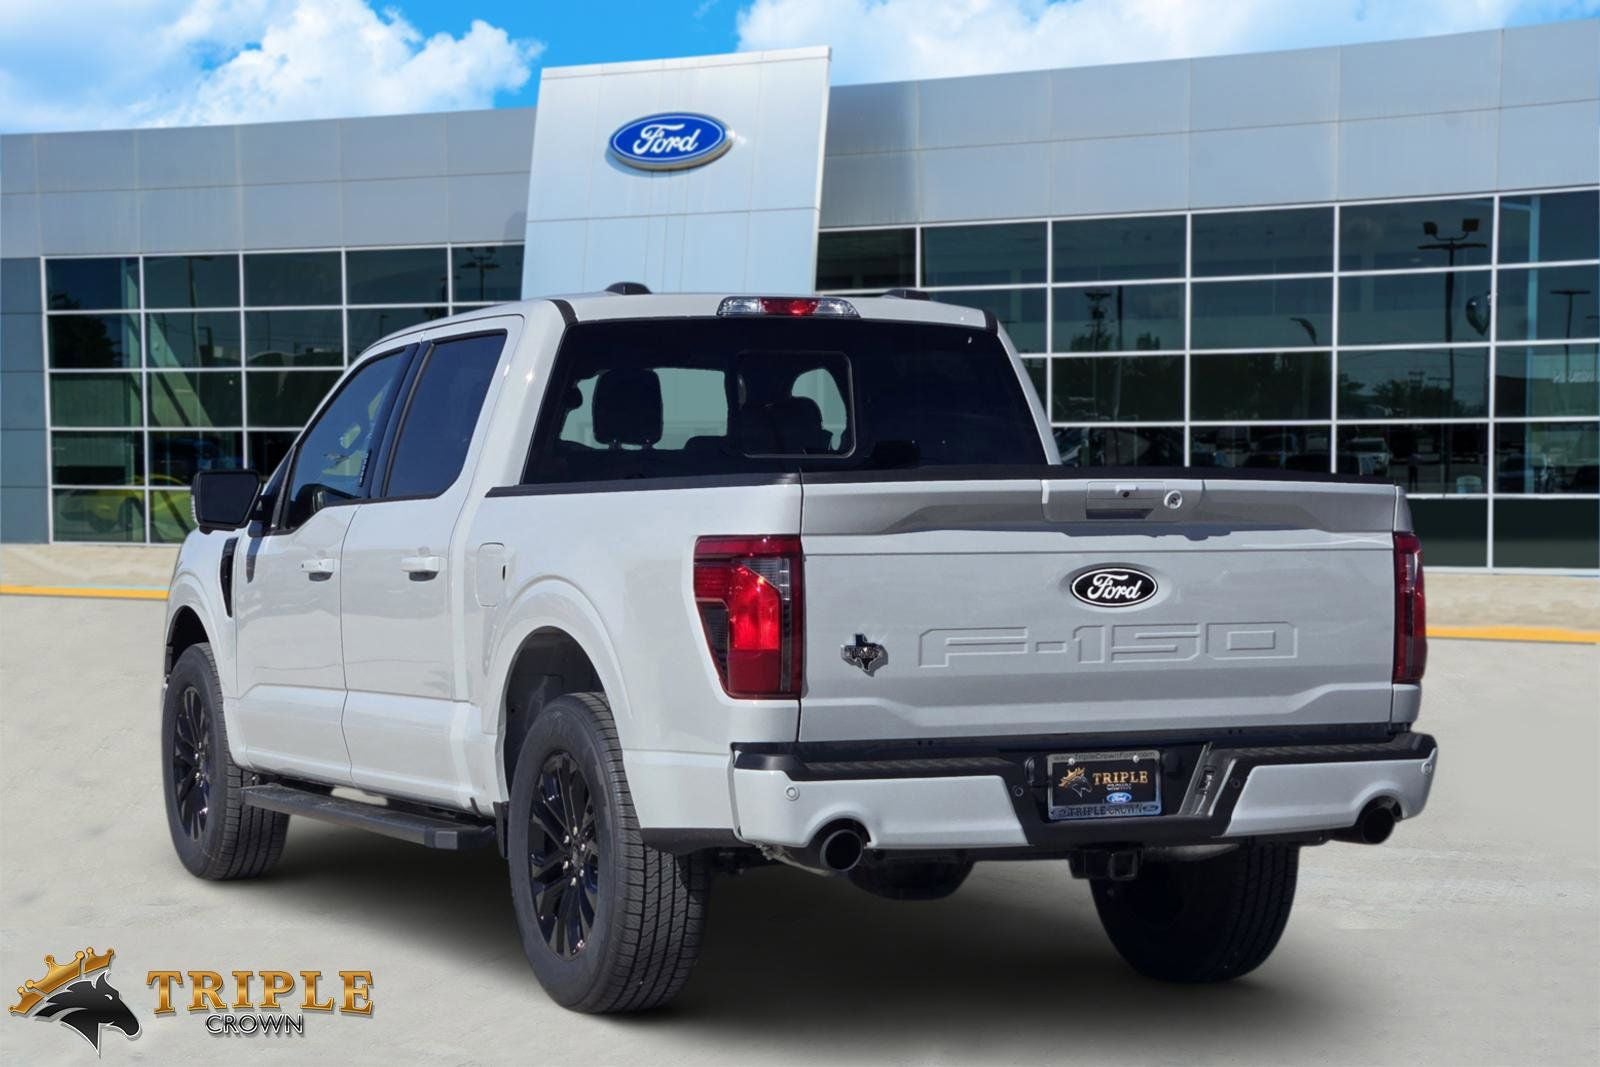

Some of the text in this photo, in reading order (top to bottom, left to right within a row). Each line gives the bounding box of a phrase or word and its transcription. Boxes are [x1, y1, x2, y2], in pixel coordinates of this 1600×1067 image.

[633, 123, 701, 155] Ford
[1087, 574, 1142, 600] Ford
[918, 622, 1298, 668] F-150
[1092, 770, 1148, 786] TRIPLE
[1068, 806, 1106, 817] TRIPLE
